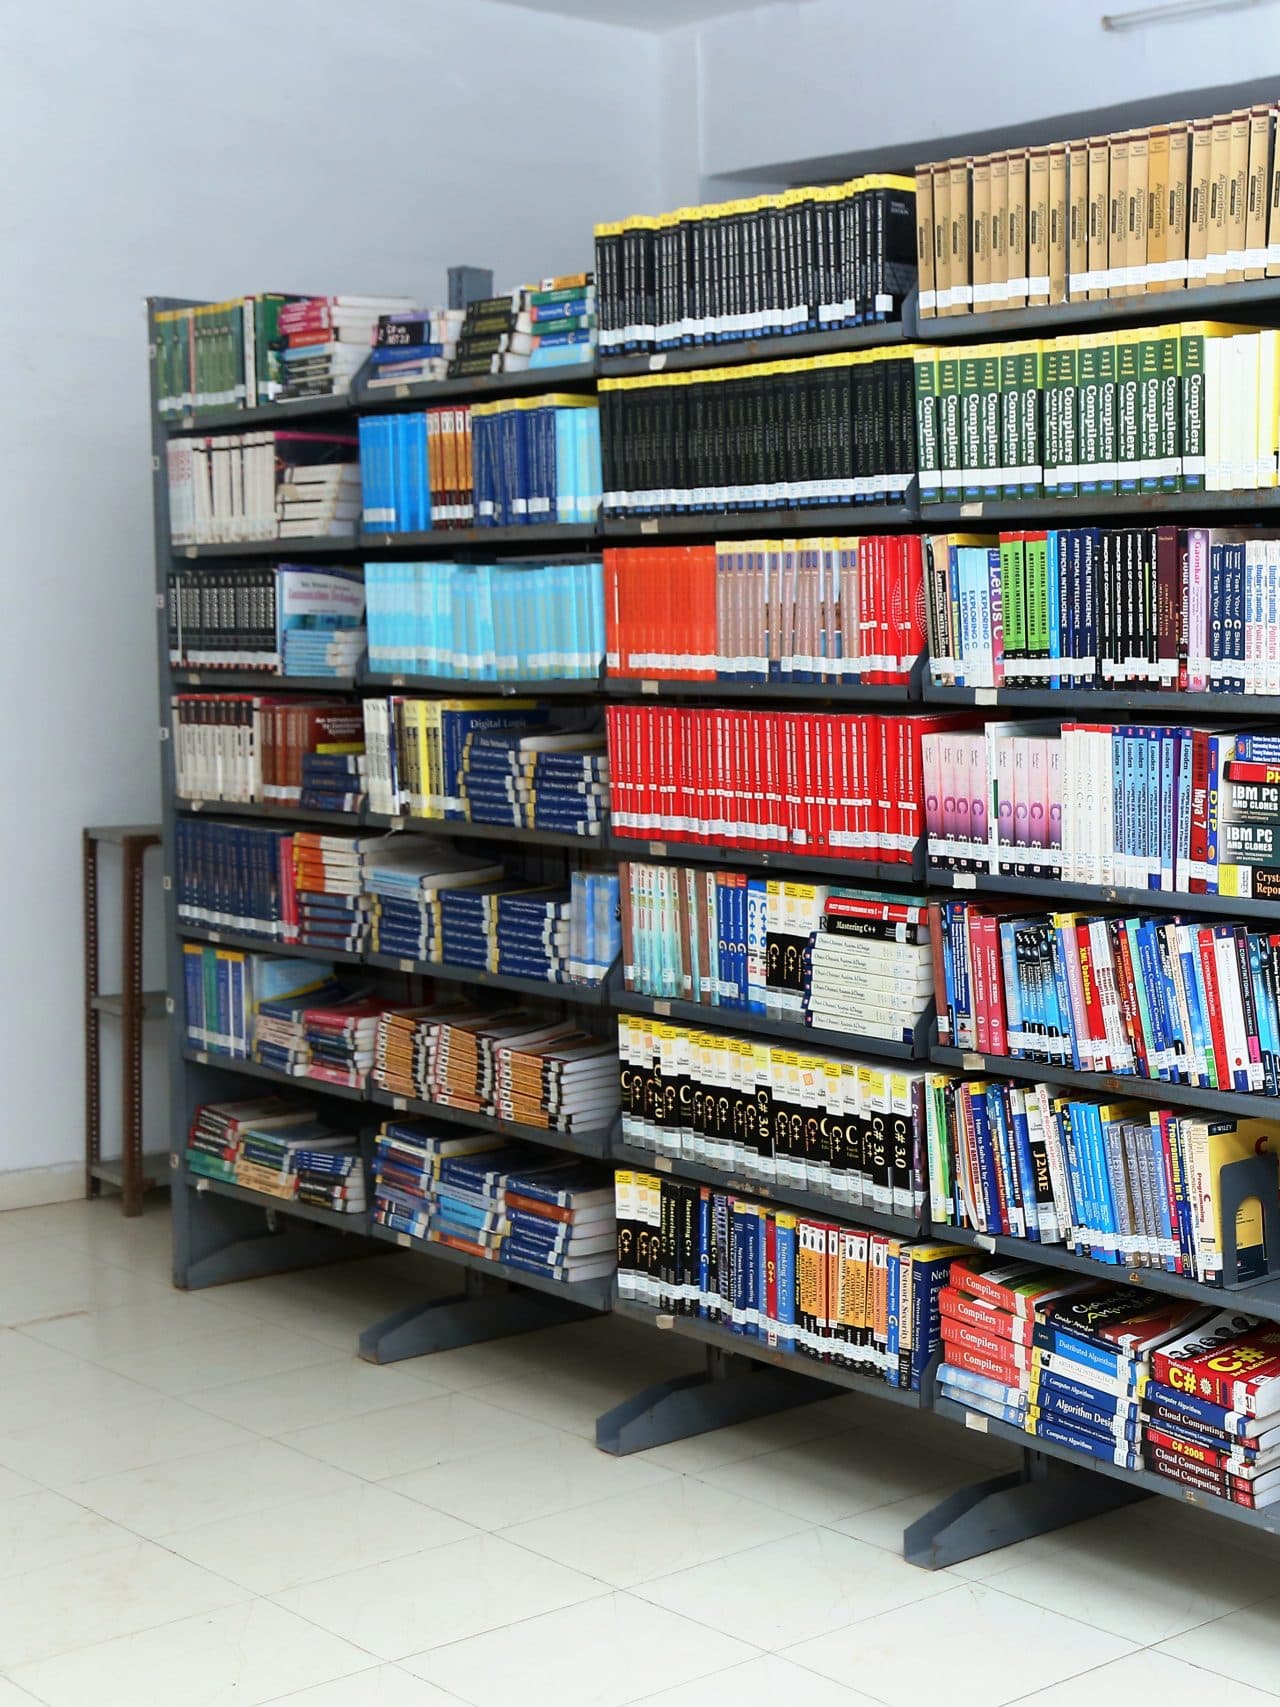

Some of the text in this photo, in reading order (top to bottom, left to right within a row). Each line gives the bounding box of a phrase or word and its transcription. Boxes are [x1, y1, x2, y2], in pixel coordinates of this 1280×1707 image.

[1217, 174, 1225, 228] Algorithms
[1235, 170, 1244, 225] Algorithms
[948, 395, 958, 468] Compilers
[969, 394, 979, 466] Compilers
[988, 393, 998, 466] Compilers
[1008, 391, 1018, 465] Compilers
[1026, 389, 1036, 464] Compilers
[1064, 387, 1074, 462] Compilers
[1086, 385, 1096, 461] Compilers
[1104, 383, 1114, 460] Compilers
[1125, 381, 1137, 459] Compilers
[1147, 379, 1159, 457] Compilers
[924, 397, 935, 469] Compilers
[991, 565, 1004, 640] Let Us C
[1269, 566, 1277, 660] Understanding Pointers
[1212, 621, 1221, 630] C
[1224, 619, 1232, 628] C
[1234, 620, 1241, 629] C
[470, 720, 497, 729] Digital
[1232, 786, 1278, 800] IBM PC
[1232, 800, 1278, 811] AND CLONES
[1194, 789, 1206, 829] Maya 7
[1209, 790, 1218, 832] DTP
[1227, 827, 1273, 842] IBM PC
[1227, 842, 1273, 852] AND CLONES
[836, 921, 875, 933] Mastering C++
[1160, 944, 1170, 976] Smarter
[1081, 966, 1092, 1005] Databases
[1128, 982, 1136, 1016] Quality
[654, 1064, 663, 1118] C# 2.0
[665, 1085, 676, 1111] C++
[680, 1085, 692, 1104] C
[719, 1097, 729, 1122] C++
[757, 1090, 769, 1137] C# 3.0
[777, 1111, 788, 1137] C++
[792, 1114, 802, 1140] C++
[807, 1118, 818, 1144] C++
[846, 1125, 858, 1145] C
[1217, 1123, 1232, 1132] WILEY
[832, 1126, 843, 1152] C++
[873, 1117, 885, 1165] C# 3.0
[894, 1120, 907, 1168] C# 3.0
[982, 1172, 987, 1180] by
[1033, 1151, 1049, 1192] J2ME
[982, 1181, 991, 1215] Computer
[1195, 1172, 1205, 1223] Programming
[1204, 1194, 1211, 1202] C
[966, 1276, 1001, 1300] Compilers
[957, 1303, 997, 1325] Compilers
[960, 1330, 998, 1351] Compilers
[963, 1351, 1003, 1373] Compilers
[1058, 1340, 1117, 1371] Distributed Algorithms
[1167, 1359, 1194, 1373] Professional
[1207, 1346, 1265, 1372] C#
[1050, 1378, 1094, 1400] Computer Algorithms
[1169, 1367, 1197, 1394] C#
[1055, 1399, 1093, 1420] Algorithm
[1155, 1392, 1202, 1416] Computer Algorithms
[1158, 1406, 1225, 1440] Cloud Computing
[1046, 1429, 1093, 1450] Computer Algorithms
[1171, 1441, 1204, 1461] C# 2005
[1155, 1448, 1220, 1482] Cloud Computing
[1159, 1462, 1221, 1496] Cloud Computing
